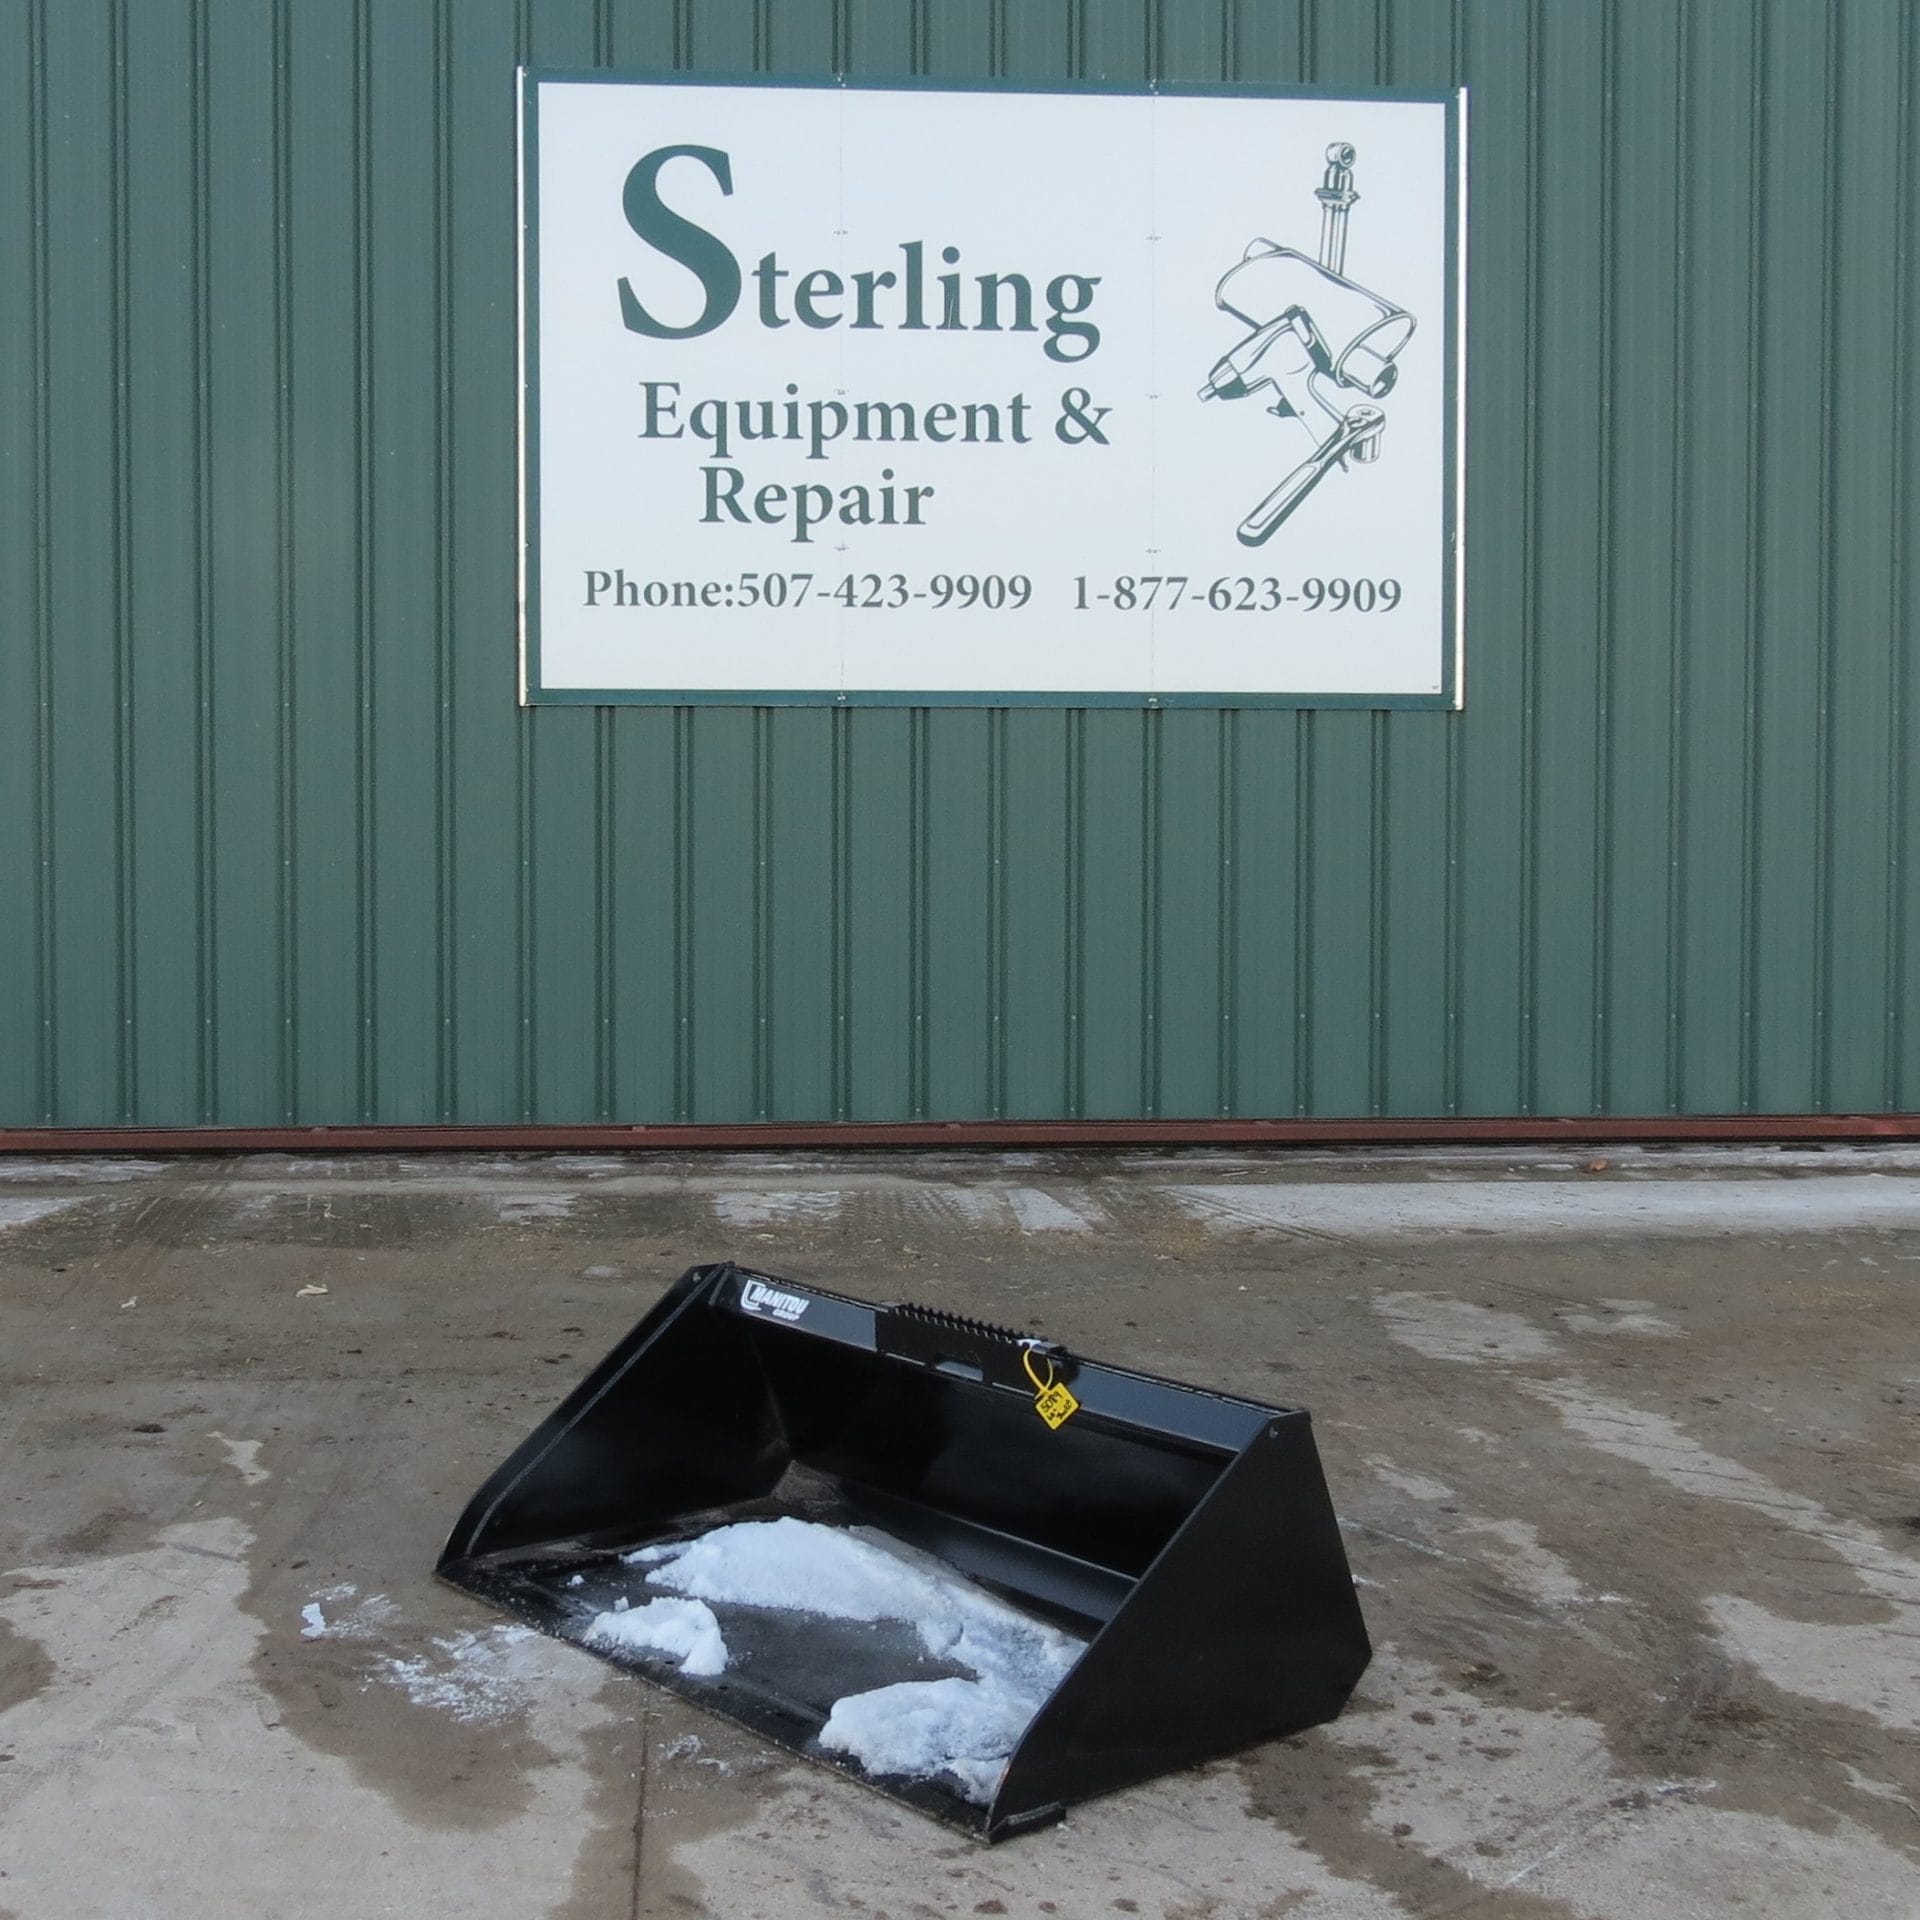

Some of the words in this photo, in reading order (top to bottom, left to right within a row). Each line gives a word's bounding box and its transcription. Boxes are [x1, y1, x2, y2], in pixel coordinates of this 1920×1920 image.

[618, 145, 1101, 362] Sterling
[638, 382, 1032, 460] Equipment
[1055, 387, 1113, 445] &
[698, 466, 935, 543] Repair
[584, 569, 1032, 609] Phone:507-423-9909
[1075, 576, 1402, 613] 1-877-623-9909
[750, 1286, 810, 1315] MANITOU
